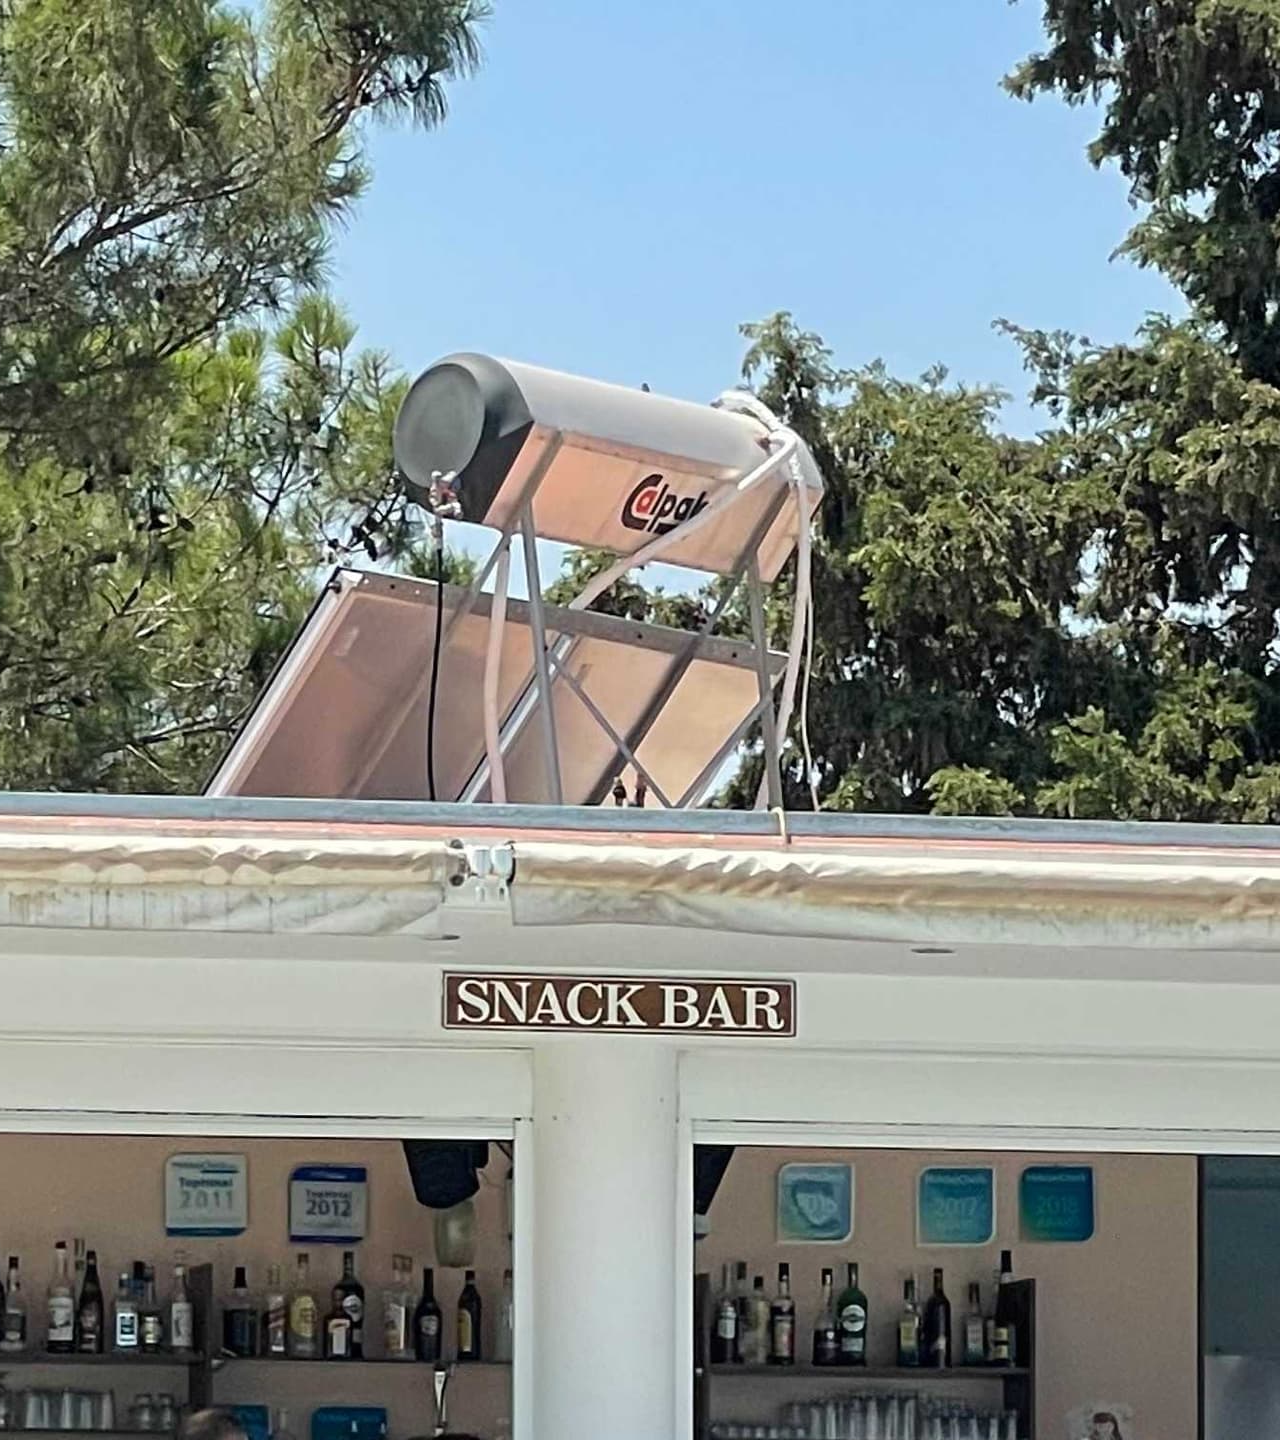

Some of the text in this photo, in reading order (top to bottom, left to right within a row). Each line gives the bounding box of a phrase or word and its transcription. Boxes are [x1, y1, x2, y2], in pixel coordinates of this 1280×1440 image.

[457, 979, 785, 1031] SNACK BAR
[179, 1189, 234, 1209] 2011
[305, 1199, 352, 1217] 2012
